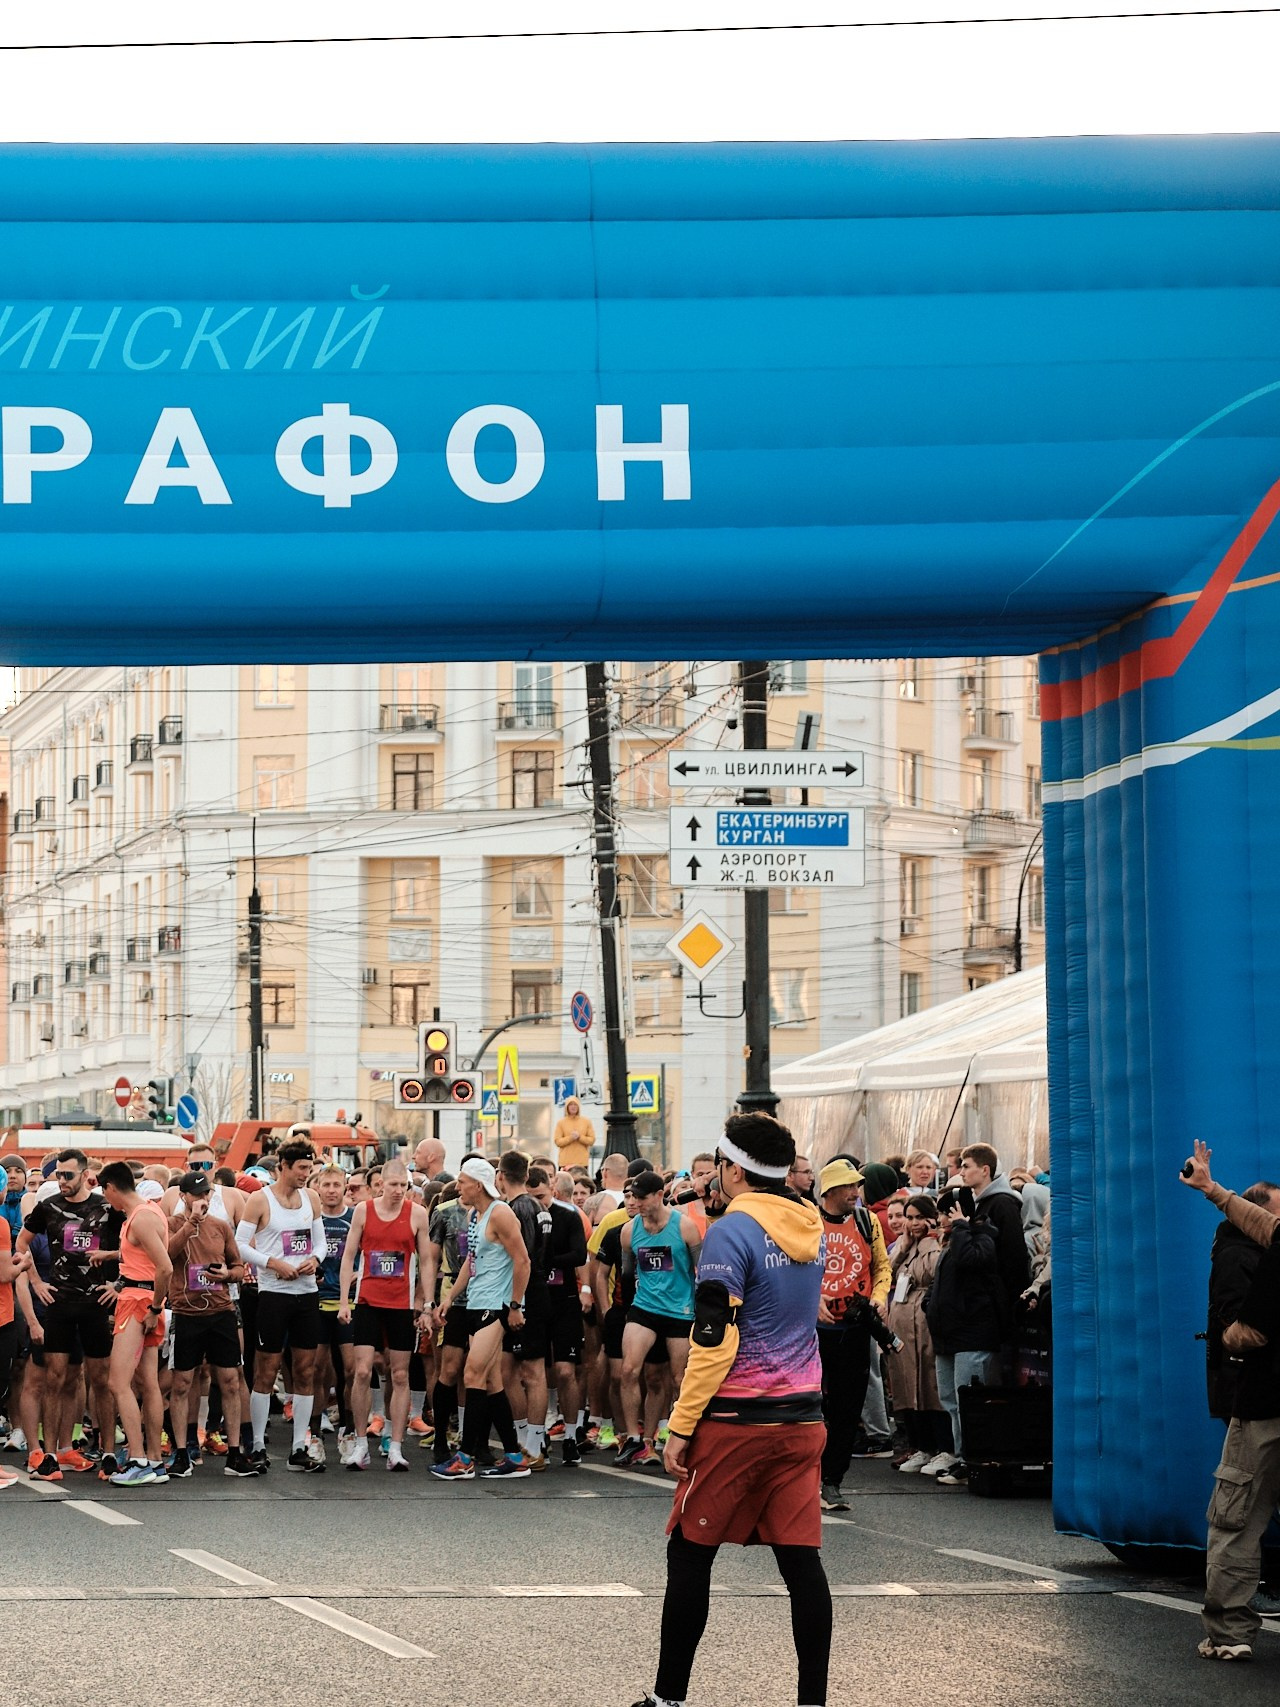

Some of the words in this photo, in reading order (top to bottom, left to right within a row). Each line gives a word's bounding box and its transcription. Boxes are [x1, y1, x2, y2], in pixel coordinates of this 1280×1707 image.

[725, 763, 827, 777] ЦВИЛЛИНГА
[719, 814, 847, 828] ЕКАТЕРИНБУРГ
[719, 830, 785, 844] КУРГАН
[720, 853, 807, 866] АЭРОПОРТ
[721, 870, 758, 883] Ж.-Д.
[768, 870, 834, 882] ВОКЗАЛ
[73, 1236, 91, 1248] 578
[291, 1240, 307, 1252] 500
[380, 1262, 394, 1272] 101
[649, 1257, 662, 1268] 47
